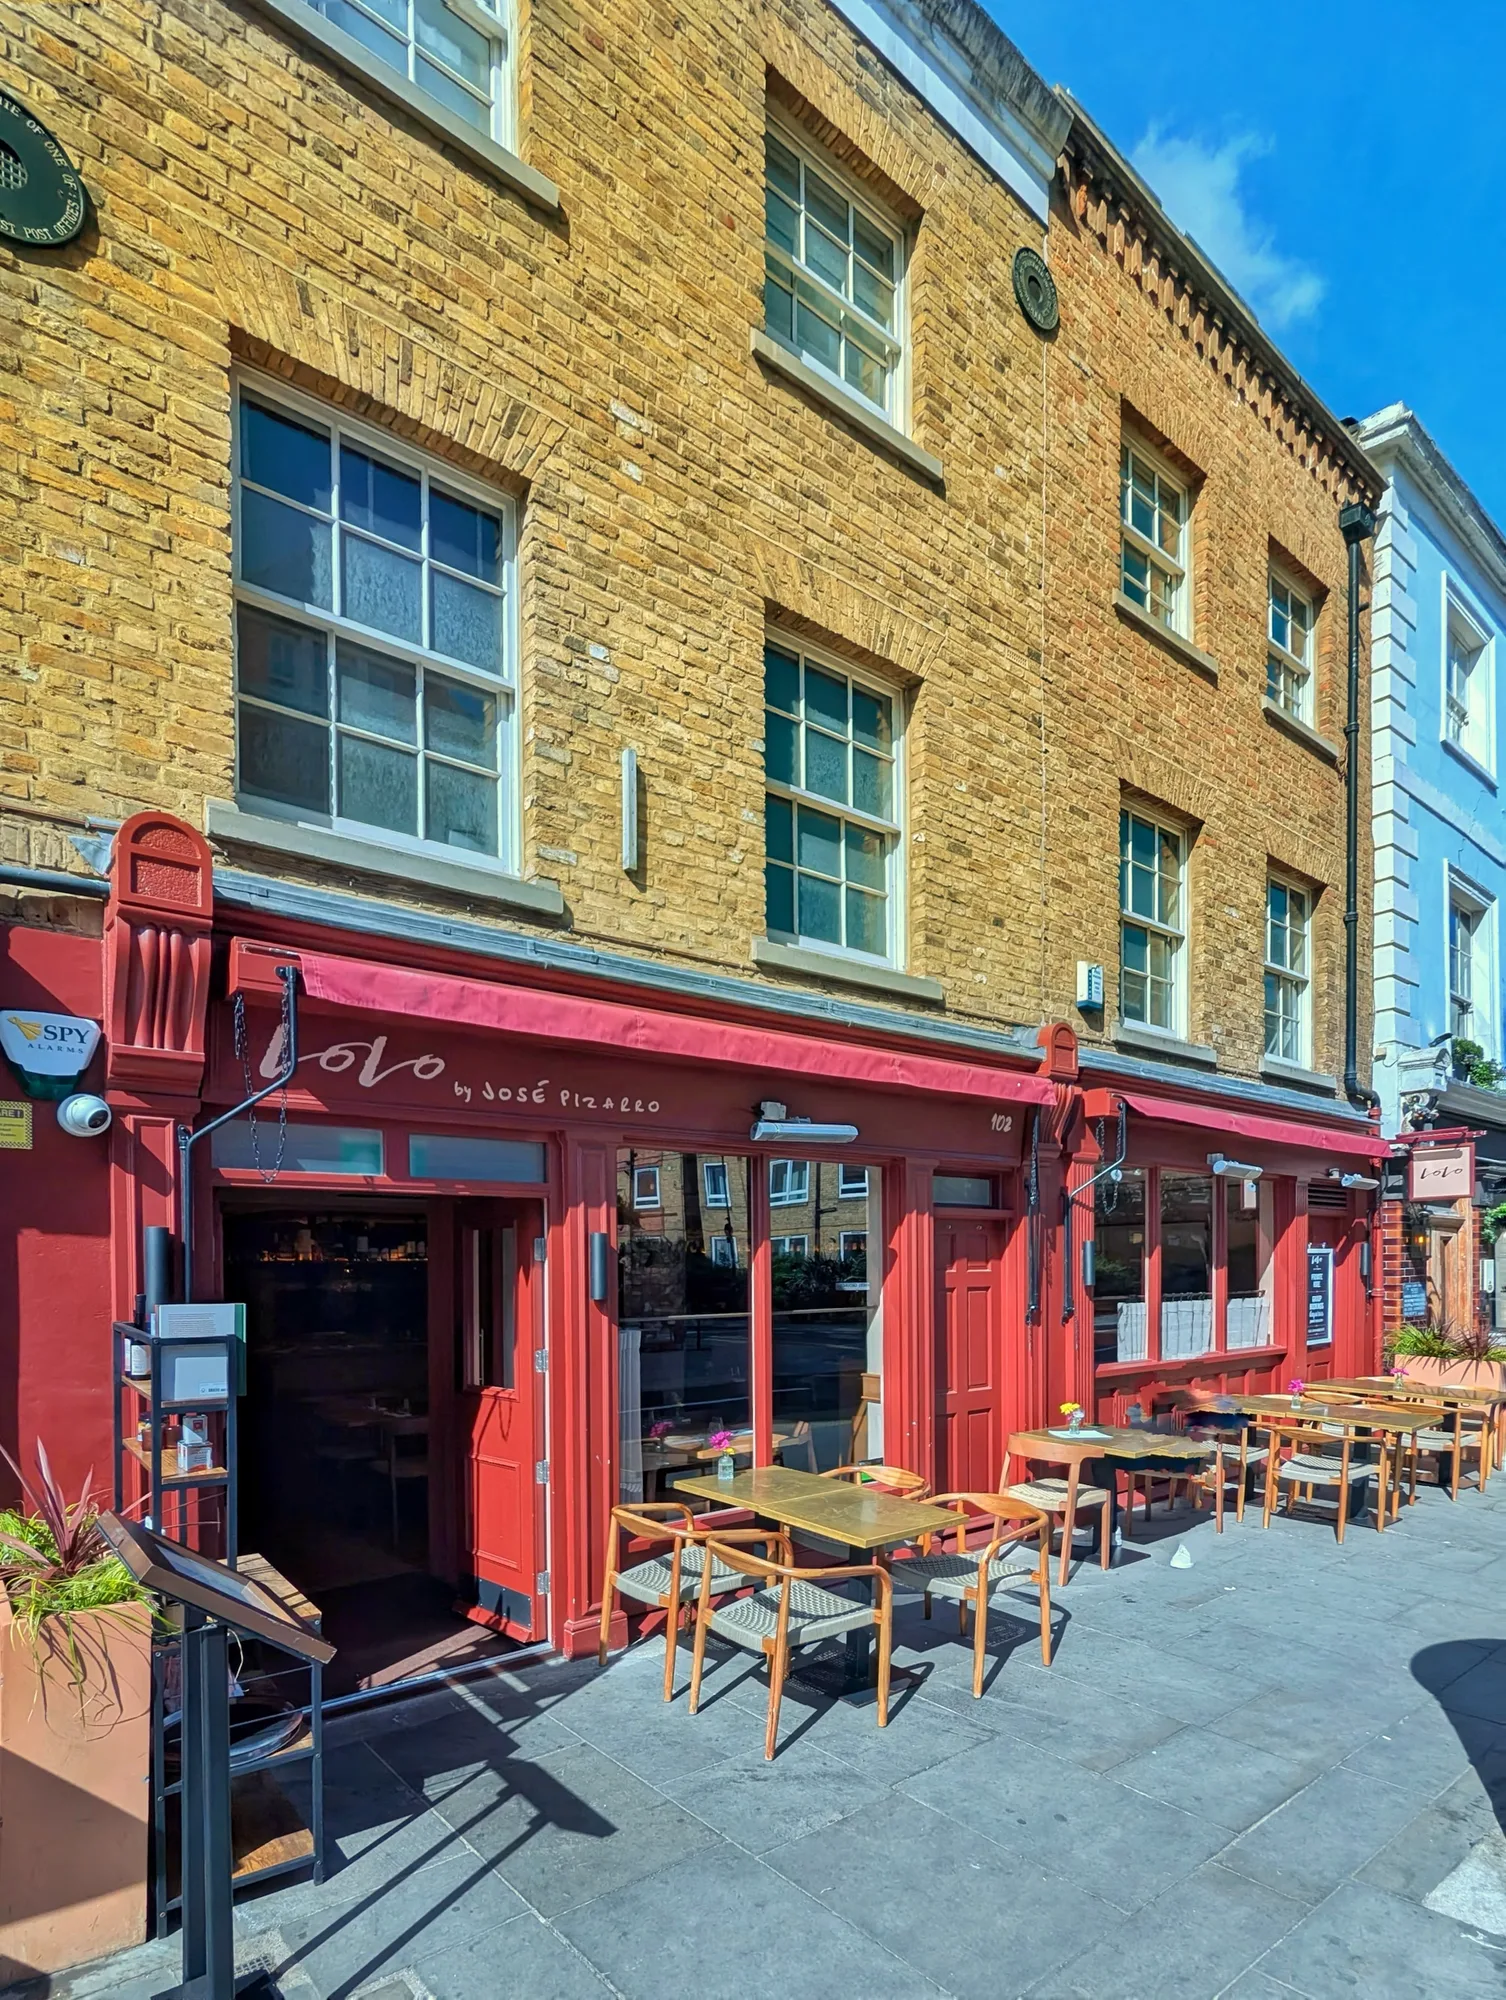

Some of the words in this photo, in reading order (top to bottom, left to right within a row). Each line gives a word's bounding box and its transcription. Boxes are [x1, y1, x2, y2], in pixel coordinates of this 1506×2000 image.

[26, 119, 46, 135] OF
[44, 141, 68, 167] ONE
[62, 173, 77, 191] OF
[22, 225, 54, 240] POST
[53, 199, 80, 236] OFFICES
[27, 1042, 84, 1054] ALARMS
[43, 1024, 90, 1045] SPY
[454, 1081, 467, 1103] by
[482, 1080, 550, 1104] JOSÉ
[560, 1089, 660, 1113] PIZARRO
[991, 1112, 1013, 1133] 102
